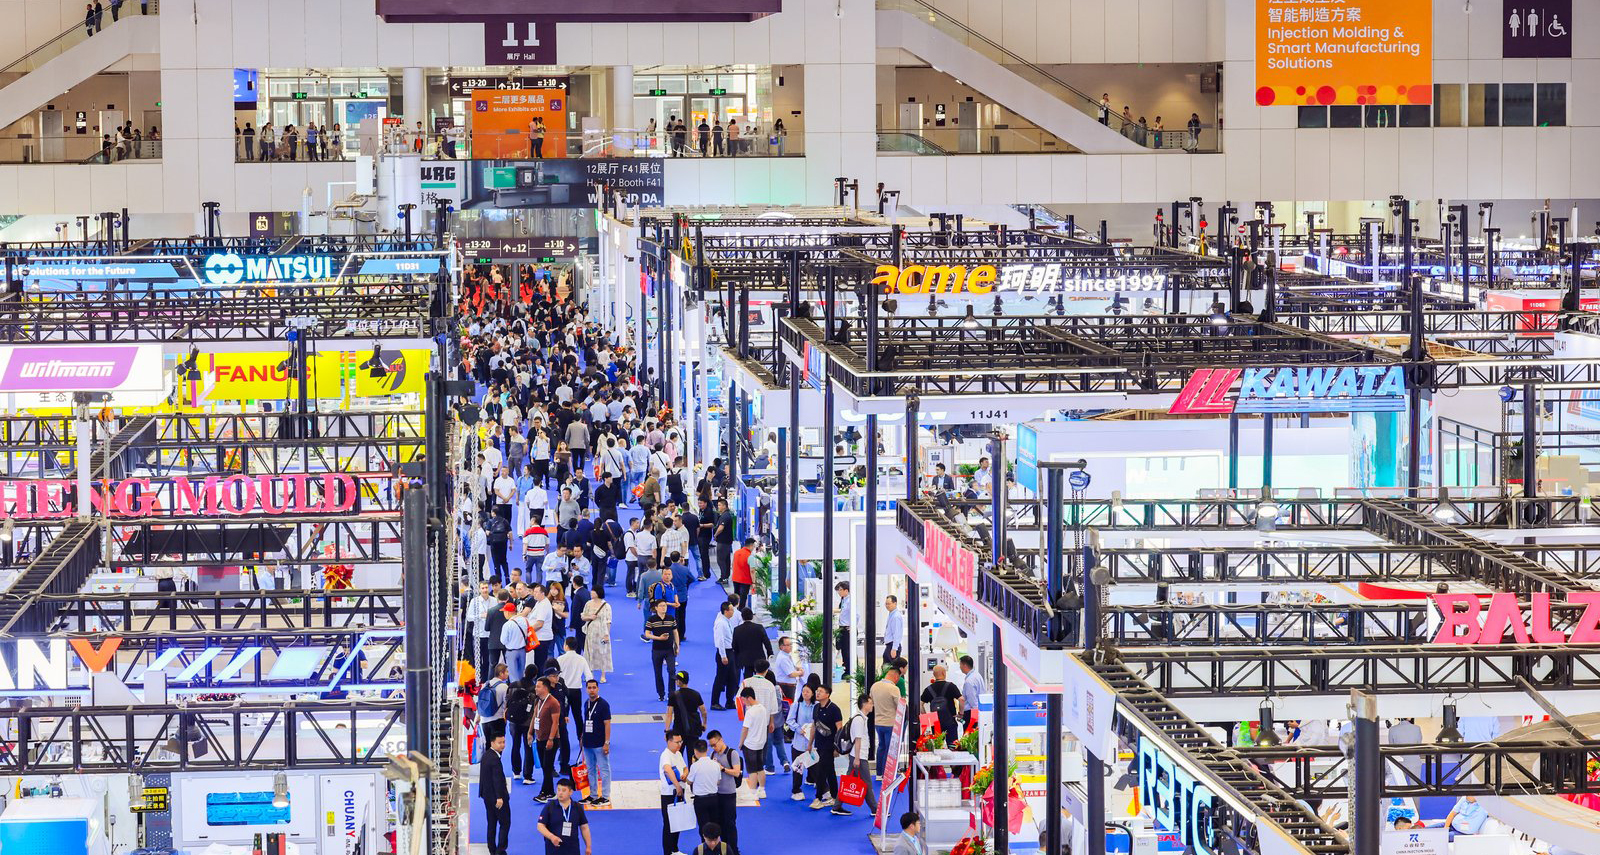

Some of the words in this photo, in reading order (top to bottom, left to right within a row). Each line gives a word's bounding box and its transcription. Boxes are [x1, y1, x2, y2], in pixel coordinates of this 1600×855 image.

[1268, 7, 1361, 22] 智能制造方案
[502, 22, 540, 47] 11
[1268, 26, 1328, 42] Injection
[1333, 26, 1389, 42] Molding
[1393, 26, 1404, 38] &
[1268, 42, 1311, 54] Smart
[1315, 41, 1420, 56] Manufacturing
[1268, 57, 1333, 69] Solutions
[511, 82, 520, 90] 12
[586, 163, 619, 174] 12展厅
[622, 163, 661, 174] F41展位
[618, 178, 643, 187] Booth
[646, 179, 661, 187] F41
[421, 191, 441, 205] 格
[642, 193, 661, 204] DA.
[517, 244, 527, 253] 12
[71, 265, 85, 275] for
[88, 265, 104, 275] the
[105, 265, 136, 275] Future
[247, 256, 331, 280] MATSUI
[395, 262, 419, 270] 11D31
[870, 264, 996, 294] acme
[998, 264, 1062, 295] 珂明
[1239, 366, 1405, 397] KAWATA
[970, 410, 1009, 419] 11J41
[172, 473, 357, 516] MOULD
[344, 790, 355, 838] CHUANY
